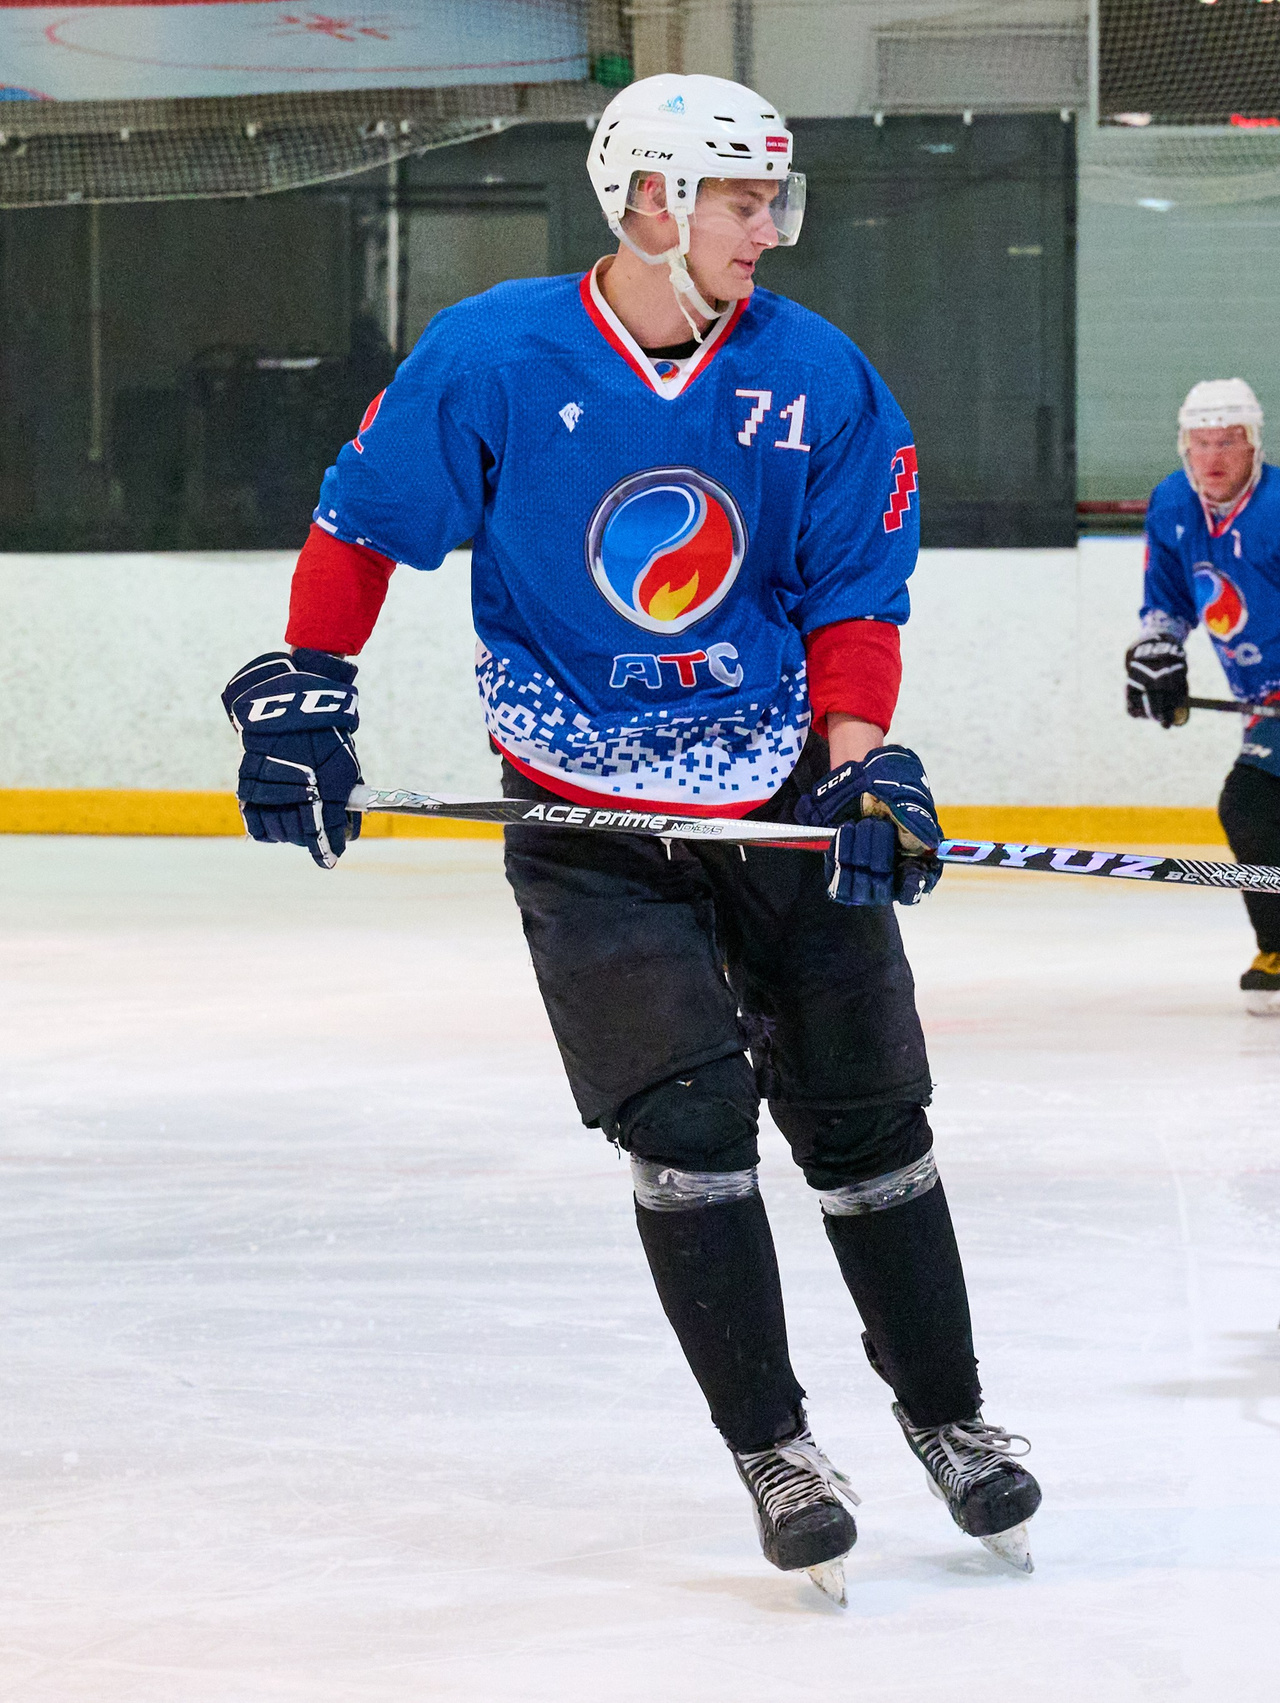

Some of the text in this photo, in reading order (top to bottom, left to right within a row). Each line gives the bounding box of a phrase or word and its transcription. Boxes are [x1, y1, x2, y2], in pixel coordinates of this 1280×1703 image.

[631, 148, 674, 160] CCM
[735, 388, 811, 452] 71
[816, 766, 852, 797] CCM
[522, 803, 591, 825] ACE
[589, 809, 668, 830] prime
[937, 839, 1167, 880] OYUZ
